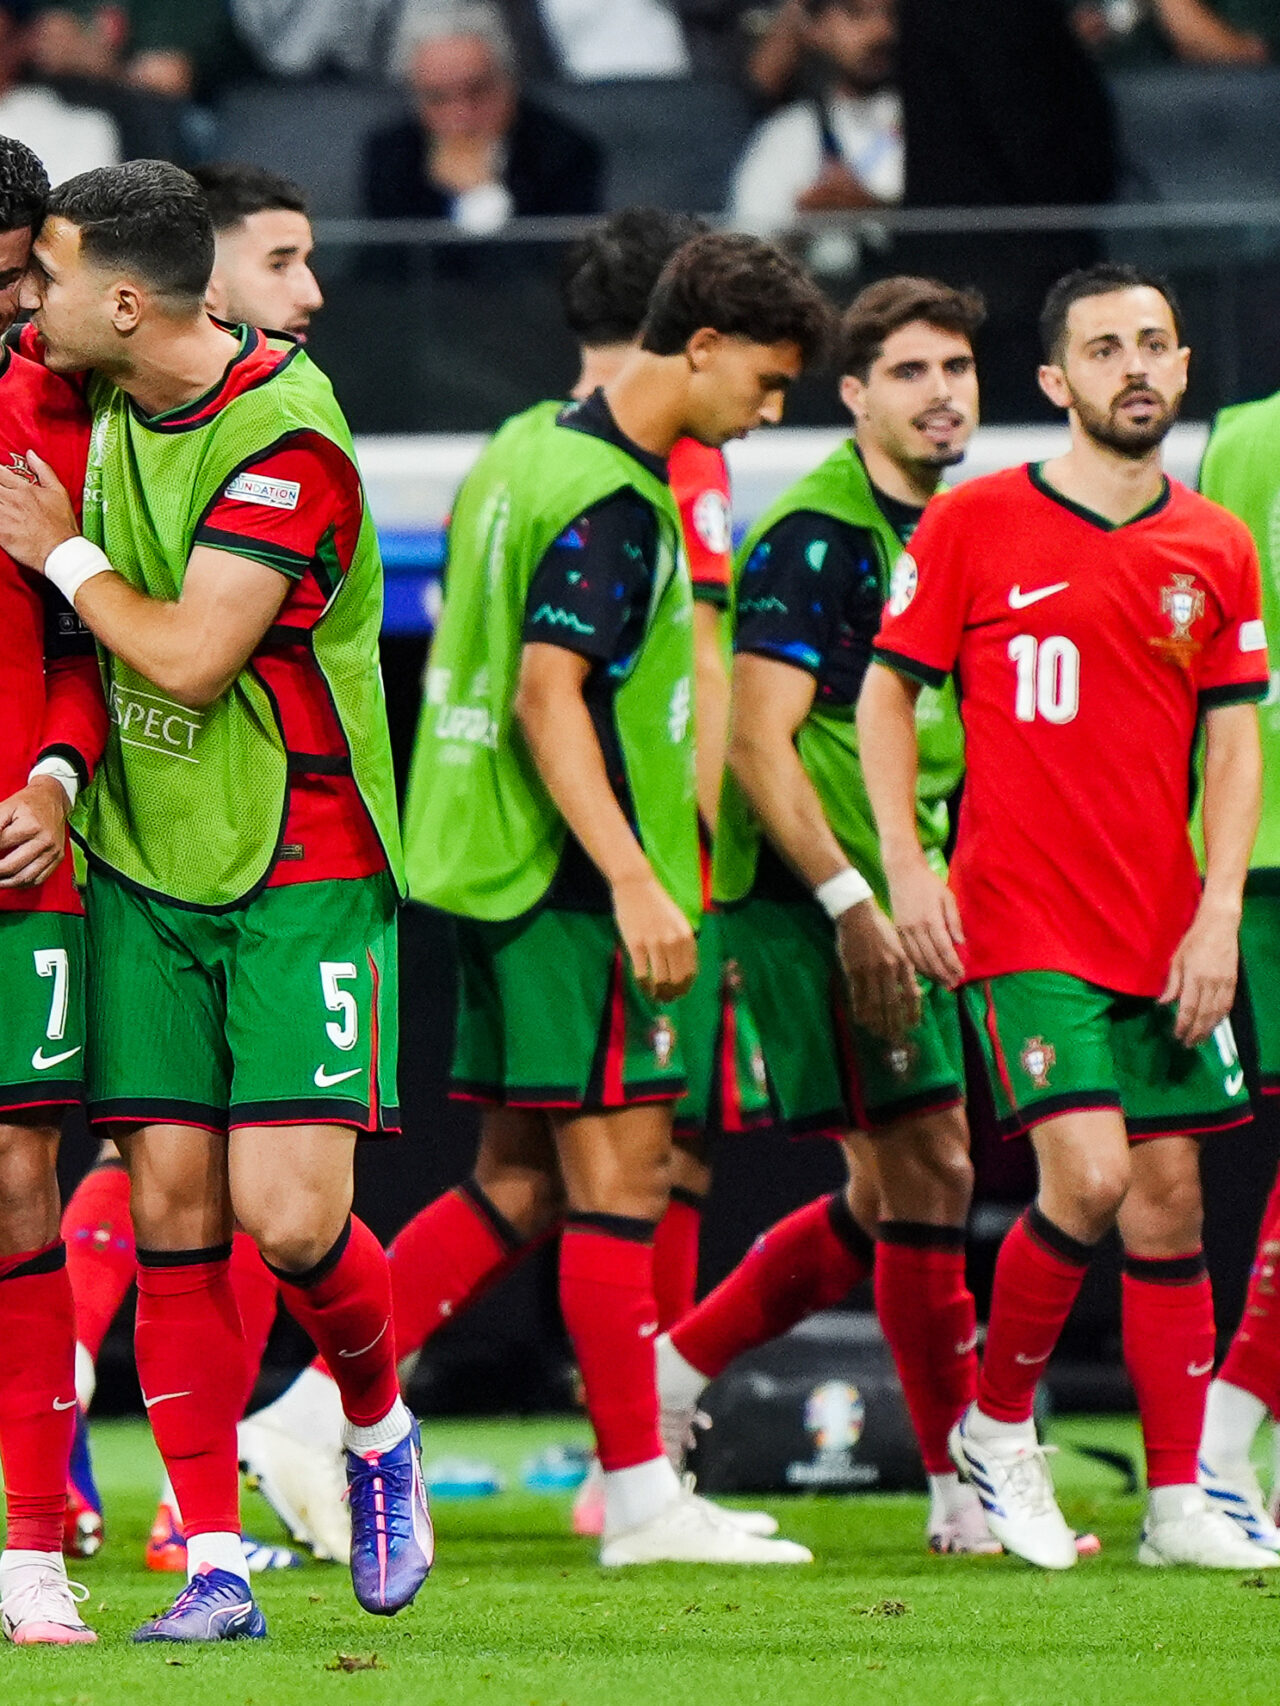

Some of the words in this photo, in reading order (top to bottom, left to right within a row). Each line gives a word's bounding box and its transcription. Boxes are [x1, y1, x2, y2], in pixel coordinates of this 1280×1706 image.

[1008, 634, 1080, 724] 10
[33, 948, 69, 1040] 7
[320, 961, 358, 1051] 5
